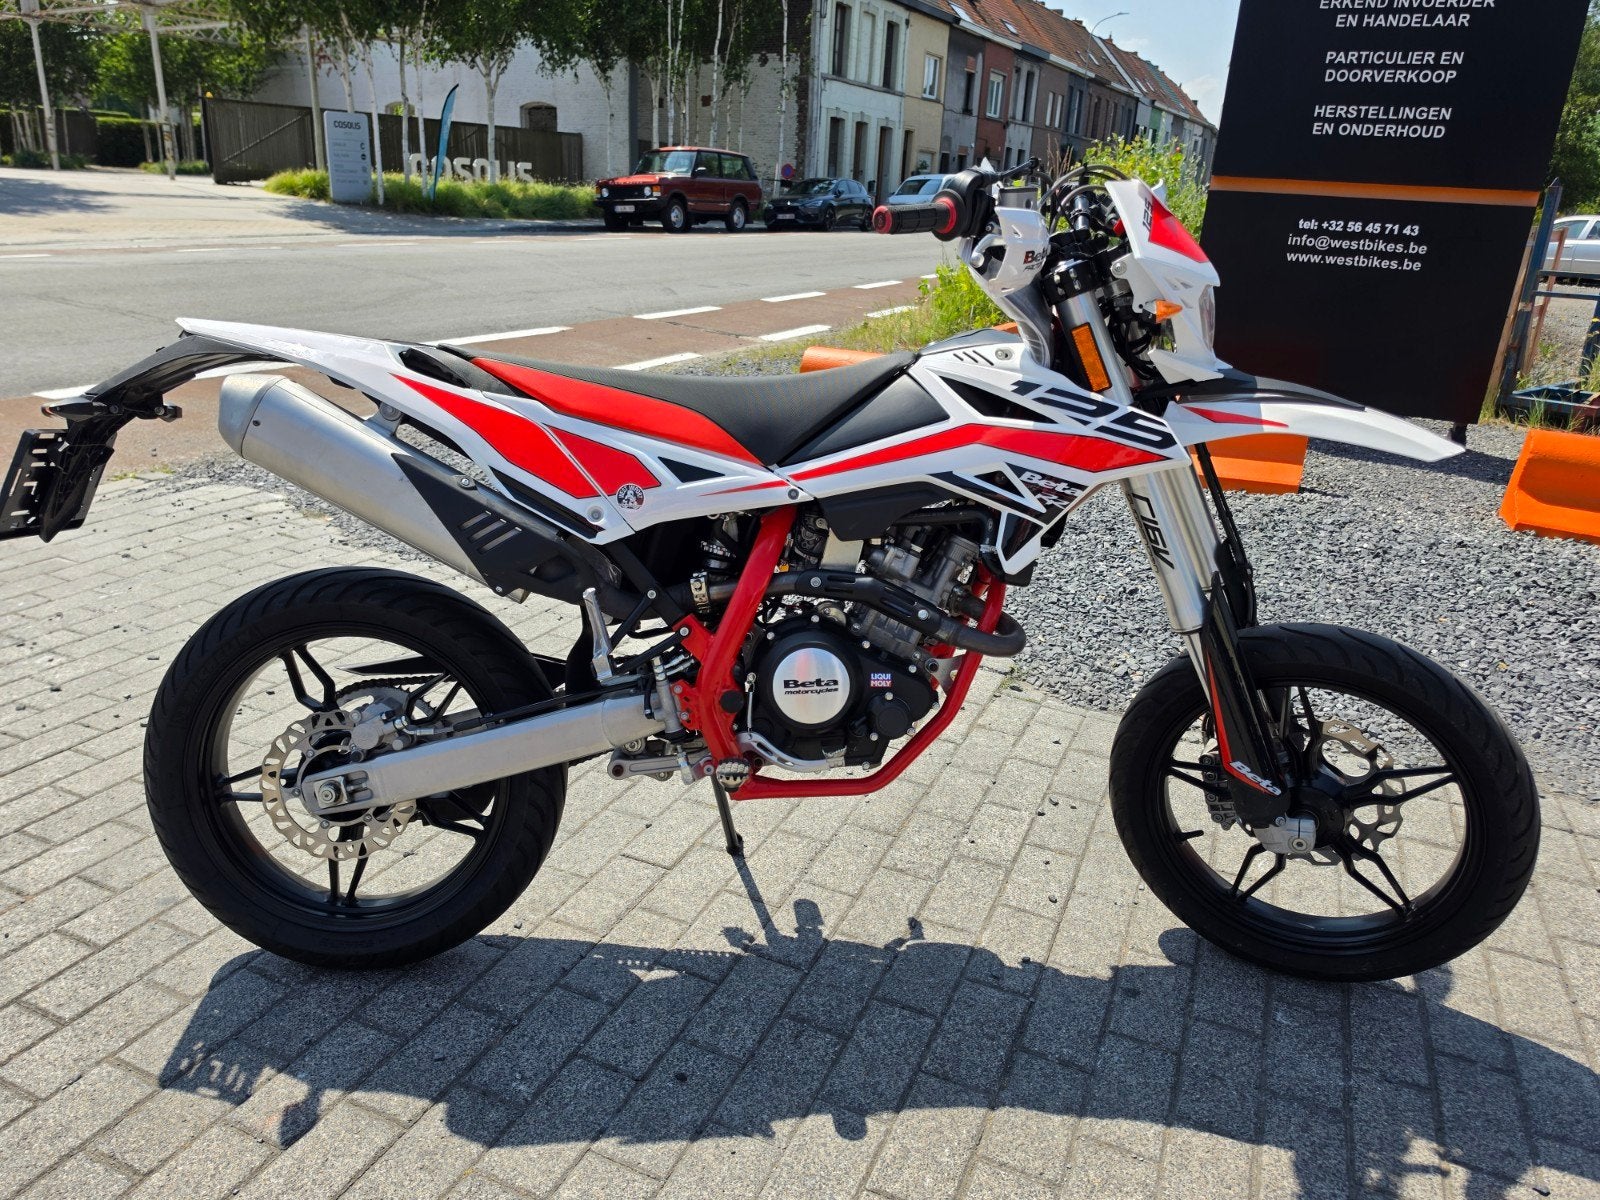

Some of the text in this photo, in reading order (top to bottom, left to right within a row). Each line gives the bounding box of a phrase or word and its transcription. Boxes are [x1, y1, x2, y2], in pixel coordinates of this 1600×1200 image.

[1320, 0, 1495, 9] ERKEND INVOERDER
[1335, 13, 1470, 28] EN HANDELAAR
[1325, 51, 1464, 65] PARTICULIER EN
[1325, 69, 1457, 83] DOORVERKOOP
[1313, 105, 1452, 120] HERSTELLINGEN
[1312, 122, 1446, 139] EN ONDERHOUD
[1299, 219, 1420, 237] tel: +32 56 45 71 43
[1287, 234, 1428, 255] info@westbikes.be
[1286, 252, 1422, 271] www.westbikes.be
[1011, 380, 1178, 450] 125
[1019, 471, 1084, 497] Beta
[783, 678, 839, 688] Beta
[784, 687, 839, 695] motorcycles
[1230, 761, 1281, 795] Beta
